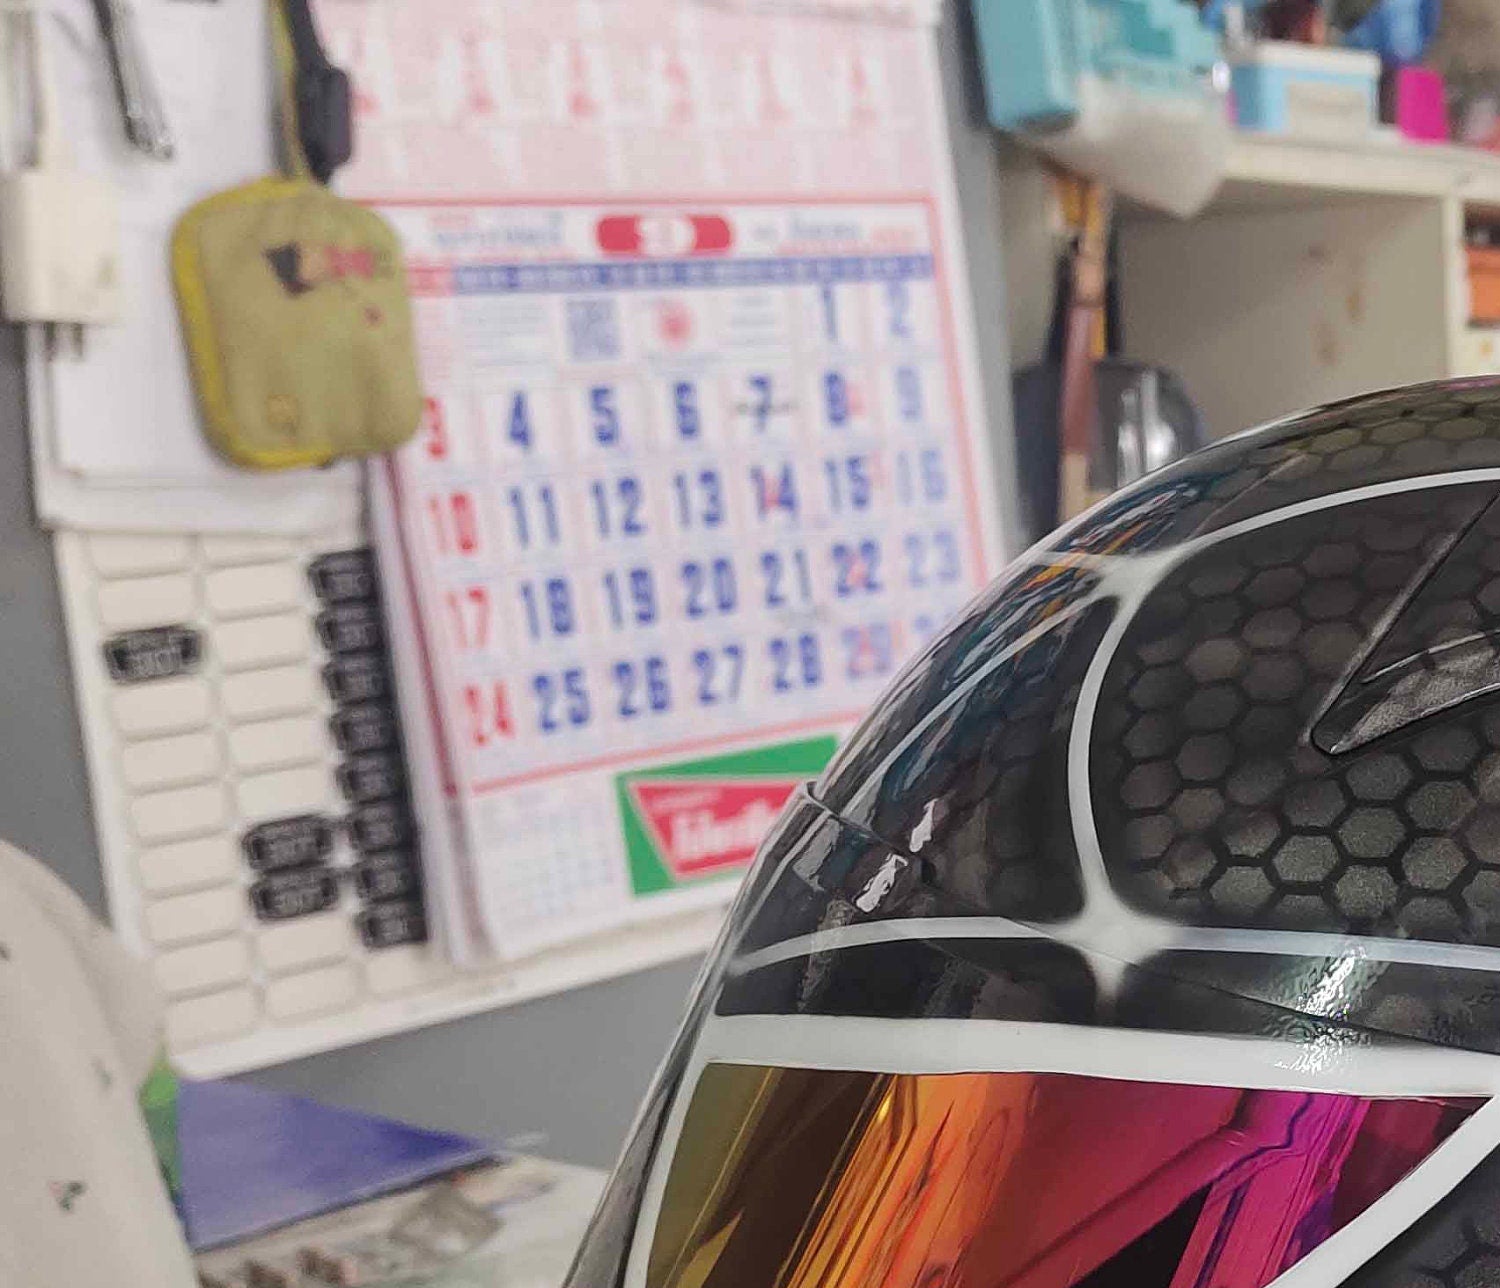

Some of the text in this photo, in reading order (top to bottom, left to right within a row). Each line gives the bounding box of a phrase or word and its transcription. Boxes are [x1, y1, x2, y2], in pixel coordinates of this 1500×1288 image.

[424, 396, 448, 460] 3
[508, 389, 533, 450] 4
[590, 383, 620, 445] 5
[672, 380, 699, 439] 6
[748, 374, 771, 433] 7
[824, 369, 847, 427] 8
[427, 491, 479, 557] 10
[507, 485, 560, 549] 11
[590, 474, 646, 540] 12
[673, 468, 723, 528] 13
[749, 461, 797, 519] 14
[823, 454, 869, 512] 15
[447, 530, 959, 648] 17 18 19 20 21 22 23
[464, 678, 515, 746] 24
[533, 664, 590, 734] 25
[615, 655, 671, 720] 26
[693, 643, 743, 704] 27
[768, 634, 821, 694] 28
